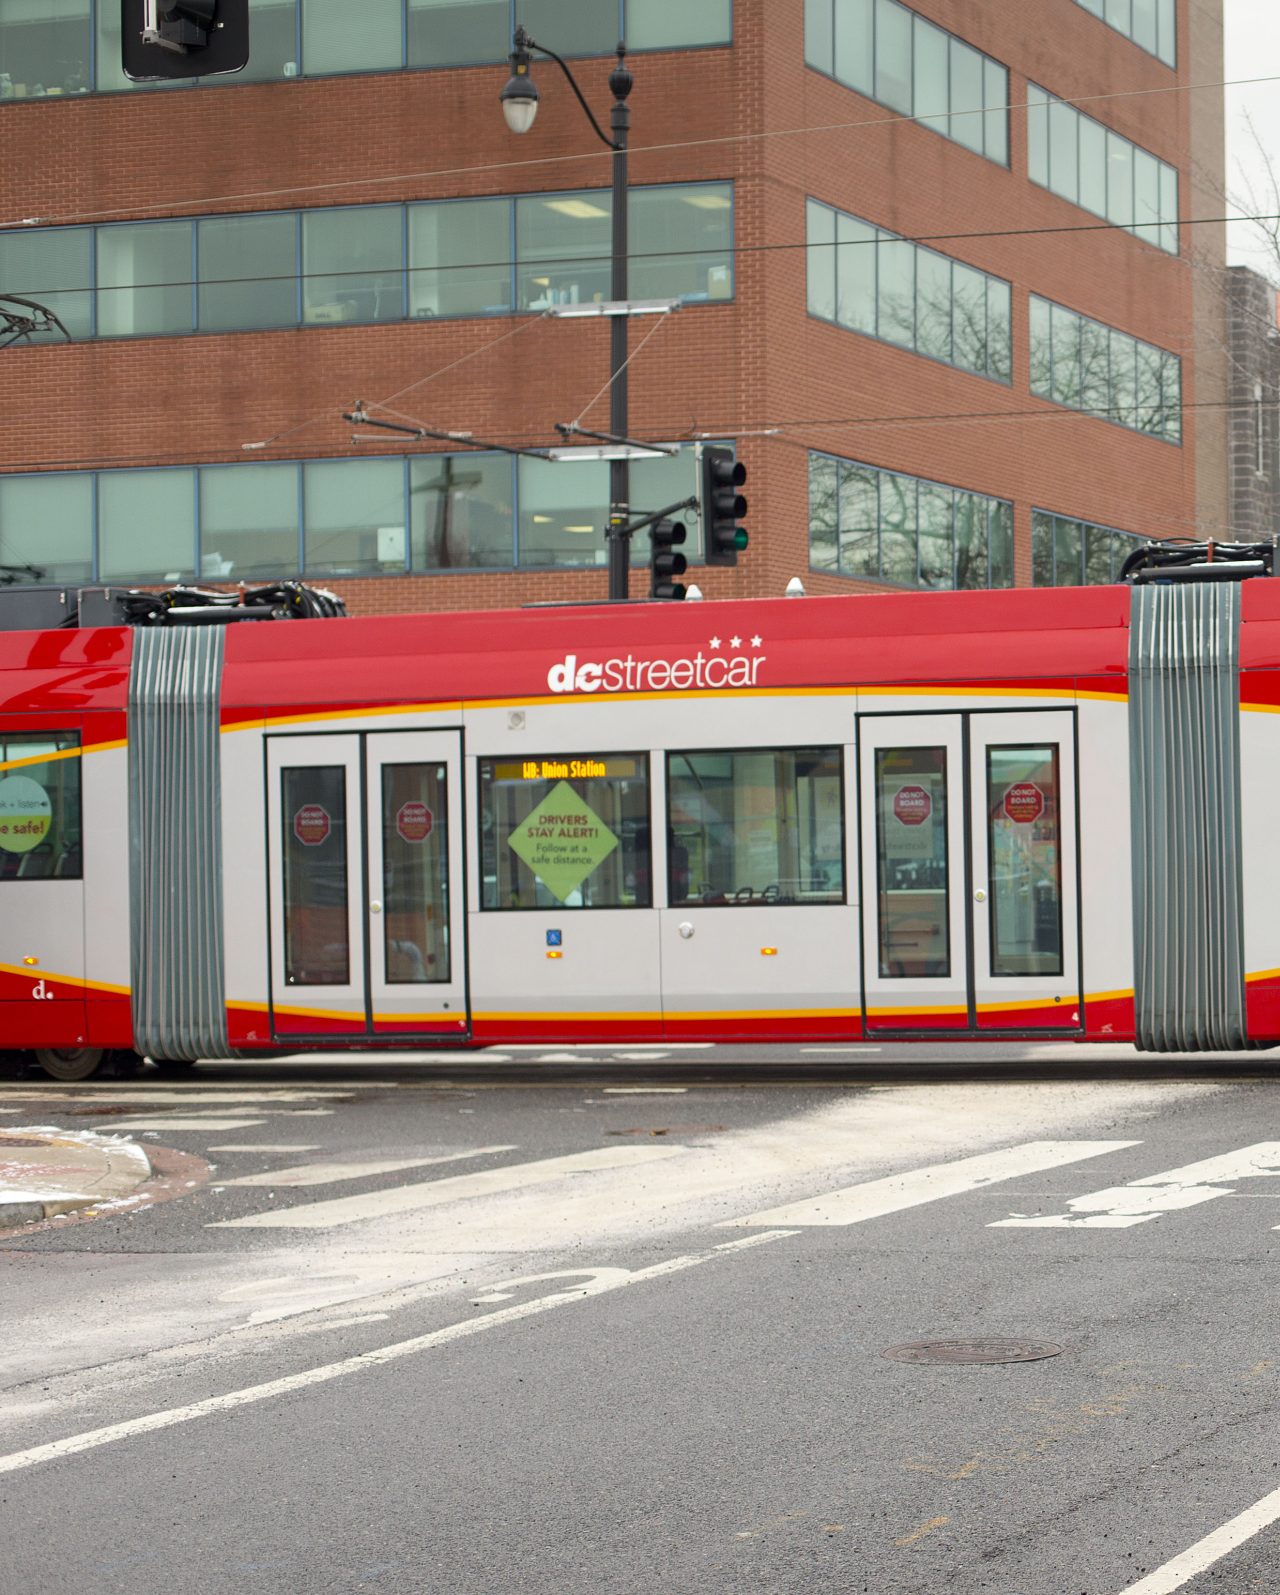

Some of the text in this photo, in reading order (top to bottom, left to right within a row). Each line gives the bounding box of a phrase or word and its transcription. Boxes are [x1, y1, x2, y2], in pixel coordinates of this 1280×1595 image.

[541, 761, 568, 778] Union
[570, 760, 606, 778] Station
[899, 791, 909, 799] DO
[1011, 788, 1036, 796] DO NOT
[899, 799, 925, 807] BOARD
[1011, 796, 1036, 804] BOARD
[539, 815, 588, 825] DRIVERS
[13, 820, 44, 834] safe!
[527, 827, 599, 838] STAY ALERT!
[536, 843, 567, 853] Follow
[570, 844, 579, 853] at
[531, 854, 549, 865] safe
[32, 979, 54, 1000] d.
